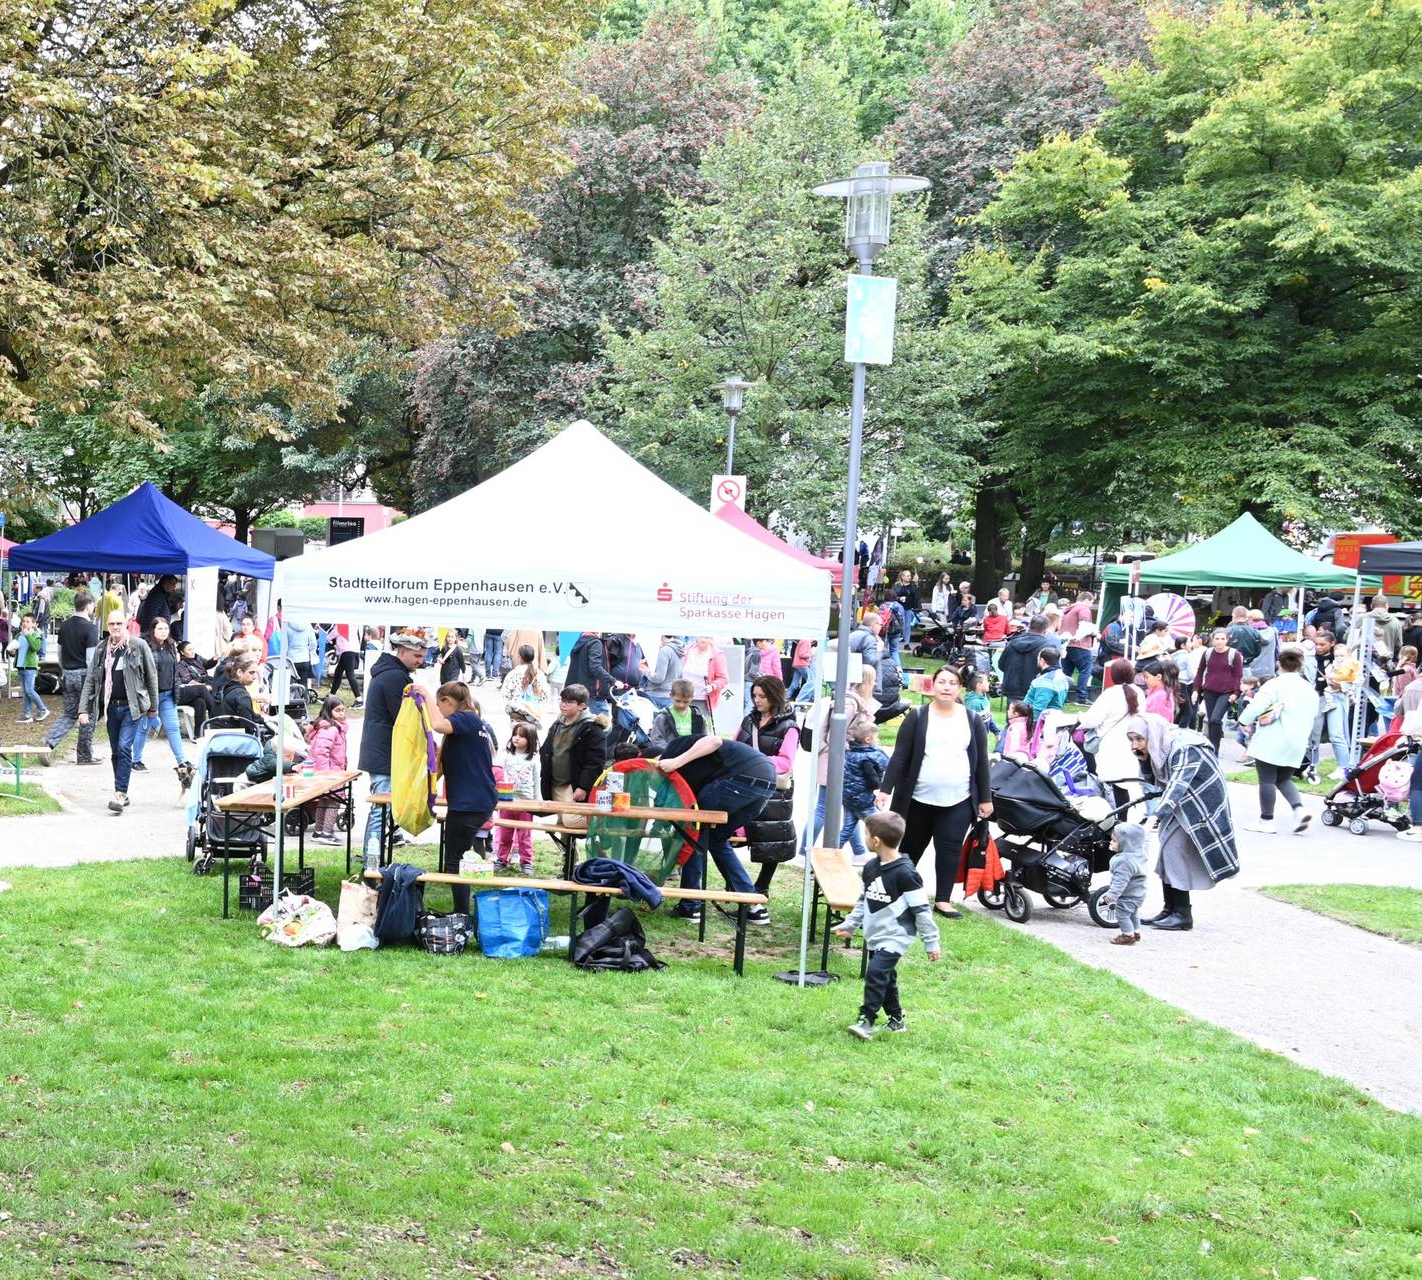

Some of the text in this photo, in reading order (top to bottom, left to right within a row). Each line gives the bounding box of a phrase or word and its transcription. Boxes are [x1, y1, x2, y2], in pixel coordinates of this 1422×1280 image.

[328, 576, 567, 595] Stadtteilforum Eppenhausen e.V.
[364, 594, 528, 608] www.hagen-eppenhausen.de
[679, 592, 753, 607] Stiftung der
[679, 606, 785, 622] Sparkasse Hagen
